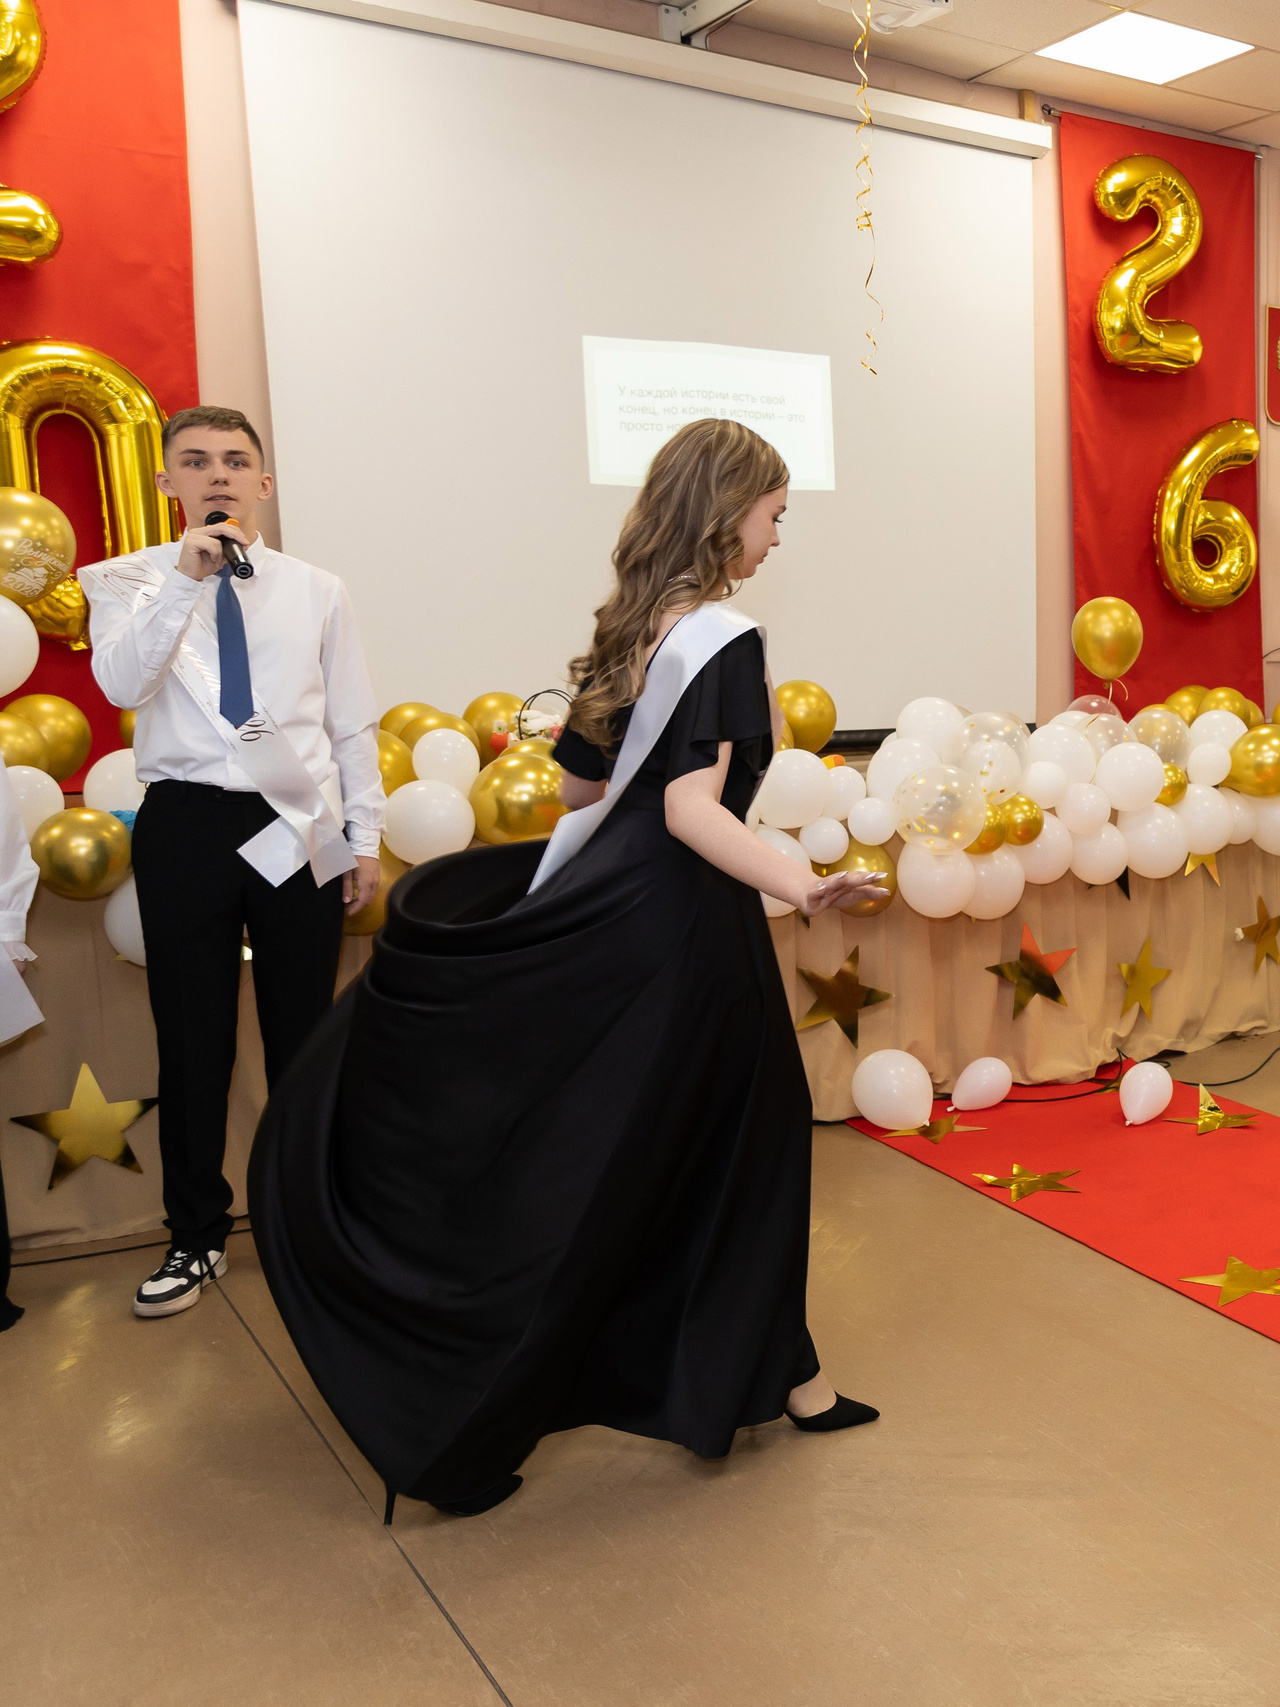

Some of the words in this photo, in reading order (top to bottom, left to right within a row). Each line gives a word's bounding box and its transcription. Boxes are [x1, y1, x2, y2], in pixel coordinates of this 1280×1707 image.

[1094, 152, 1204, 375] 2
[618, 386, 627, 397] У
[630, 387, 677, 400] каждой
[681, 389, 729, 401] истории
[732, 393, 757, 403] есть
[760, 394, 786, 406] свой
[619, 405, 660, 416] конец,
[663, 406, 679, 415] но
[682, 406, 717, 417] конец
[720, 408, 726, 417] в
[730, 408, 776, 421] истории
[788, 414, 806, 423] это
[619, 421, 663, 433] просто
[1153, 417, 1260, 613] 6
[5, 576, 39, 598] 2026
